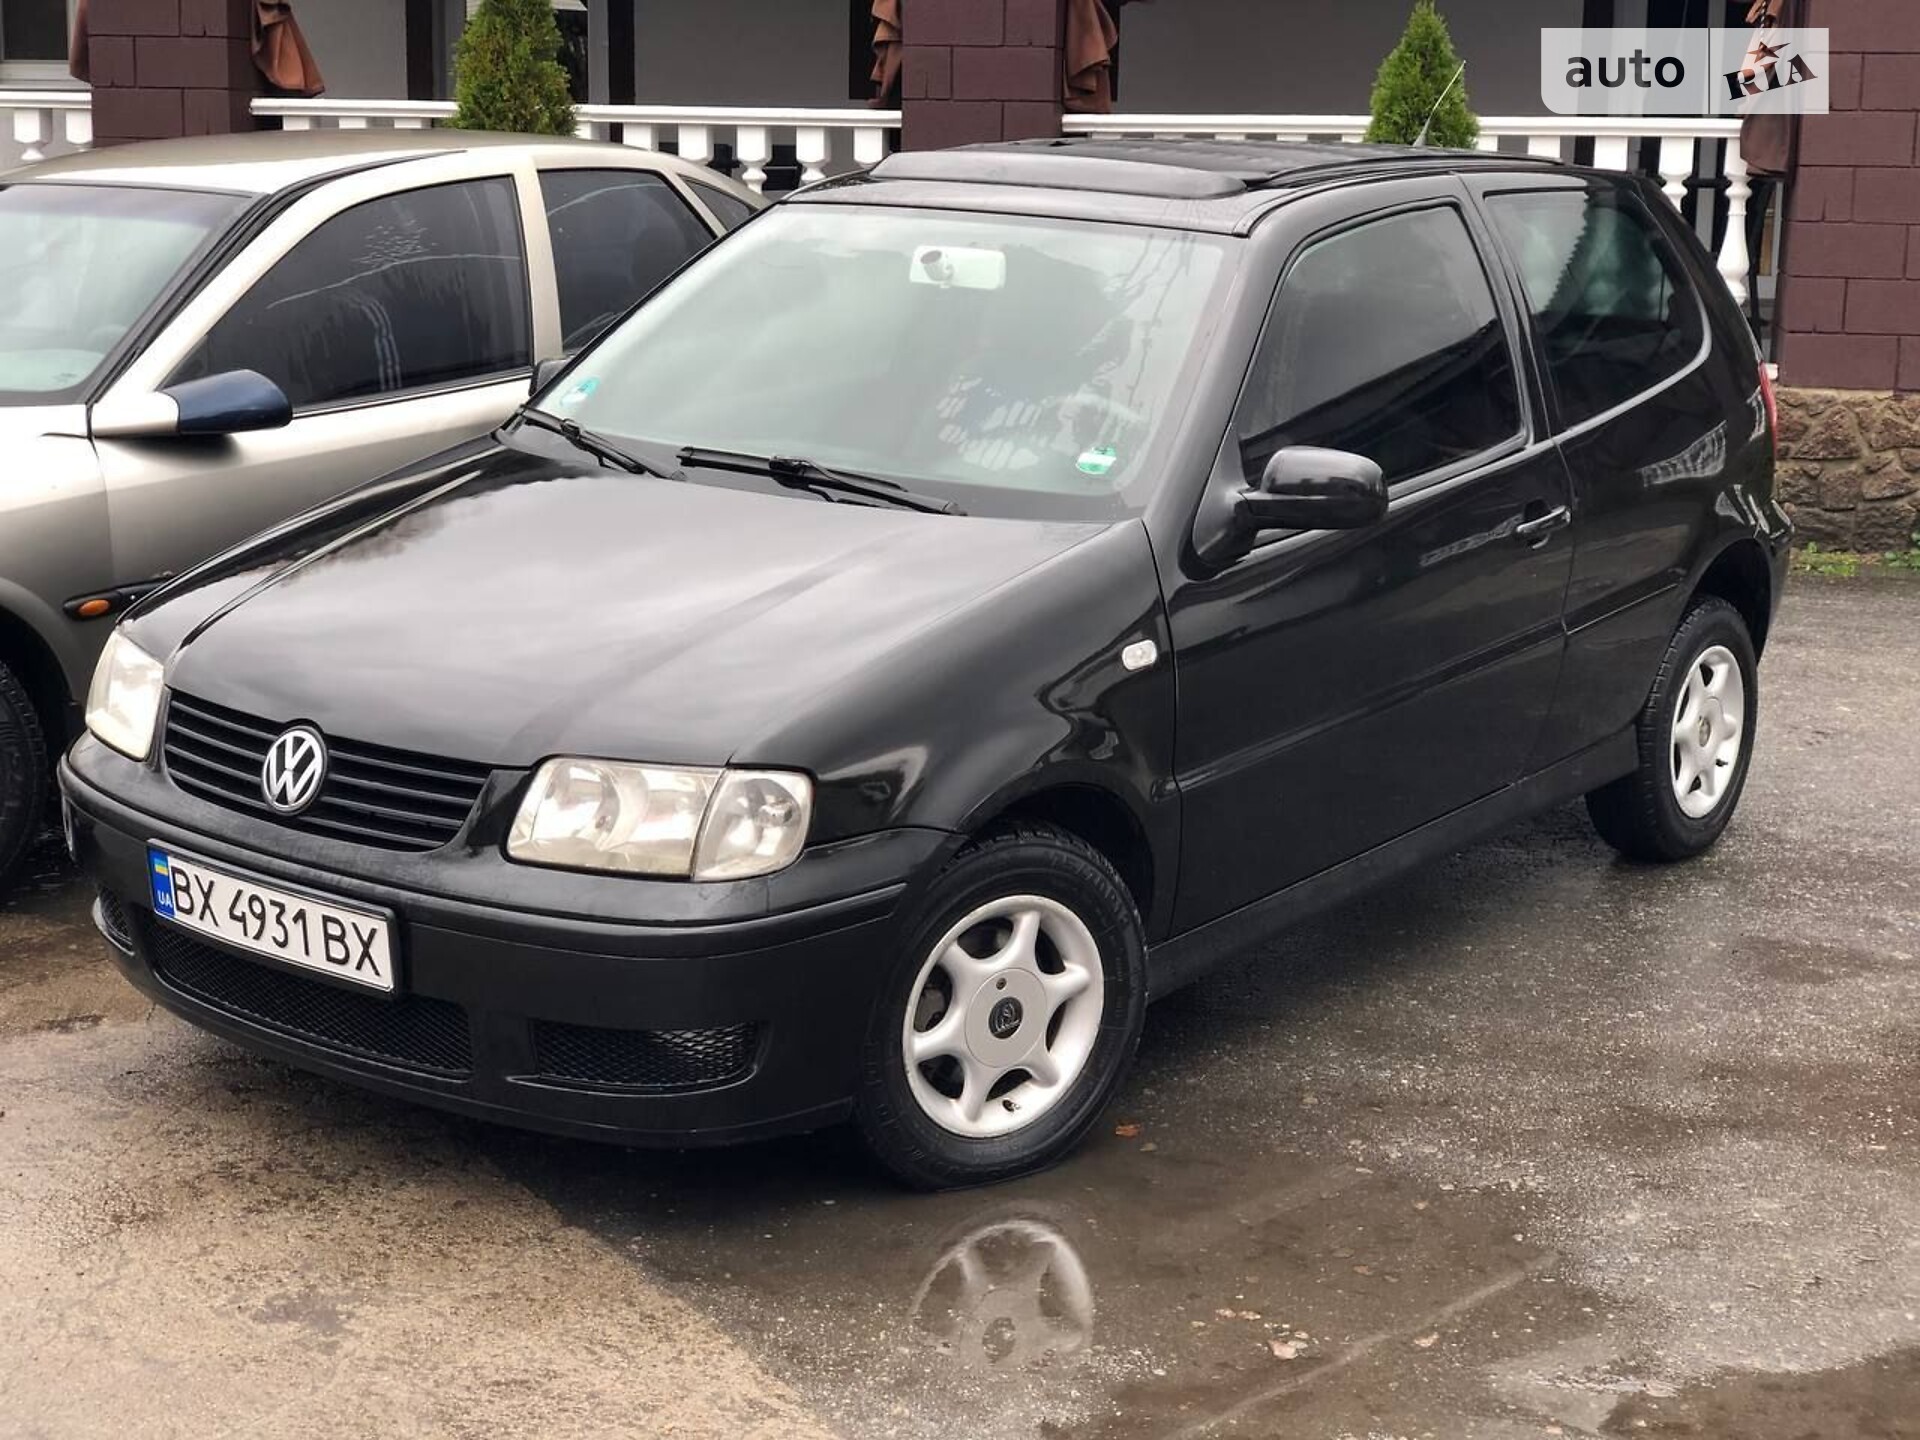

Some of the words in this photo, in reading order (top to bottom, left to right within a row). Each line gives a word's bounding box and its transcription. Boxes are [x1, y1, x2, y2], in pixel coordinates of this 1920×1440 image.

[263, 730, 323, 809] VW
[157, 890, 173, 908] UA
[170, 865, 219, 926] BX
[229, 889, 310, 956] 4931
[322, 914, 380, 977] BX
